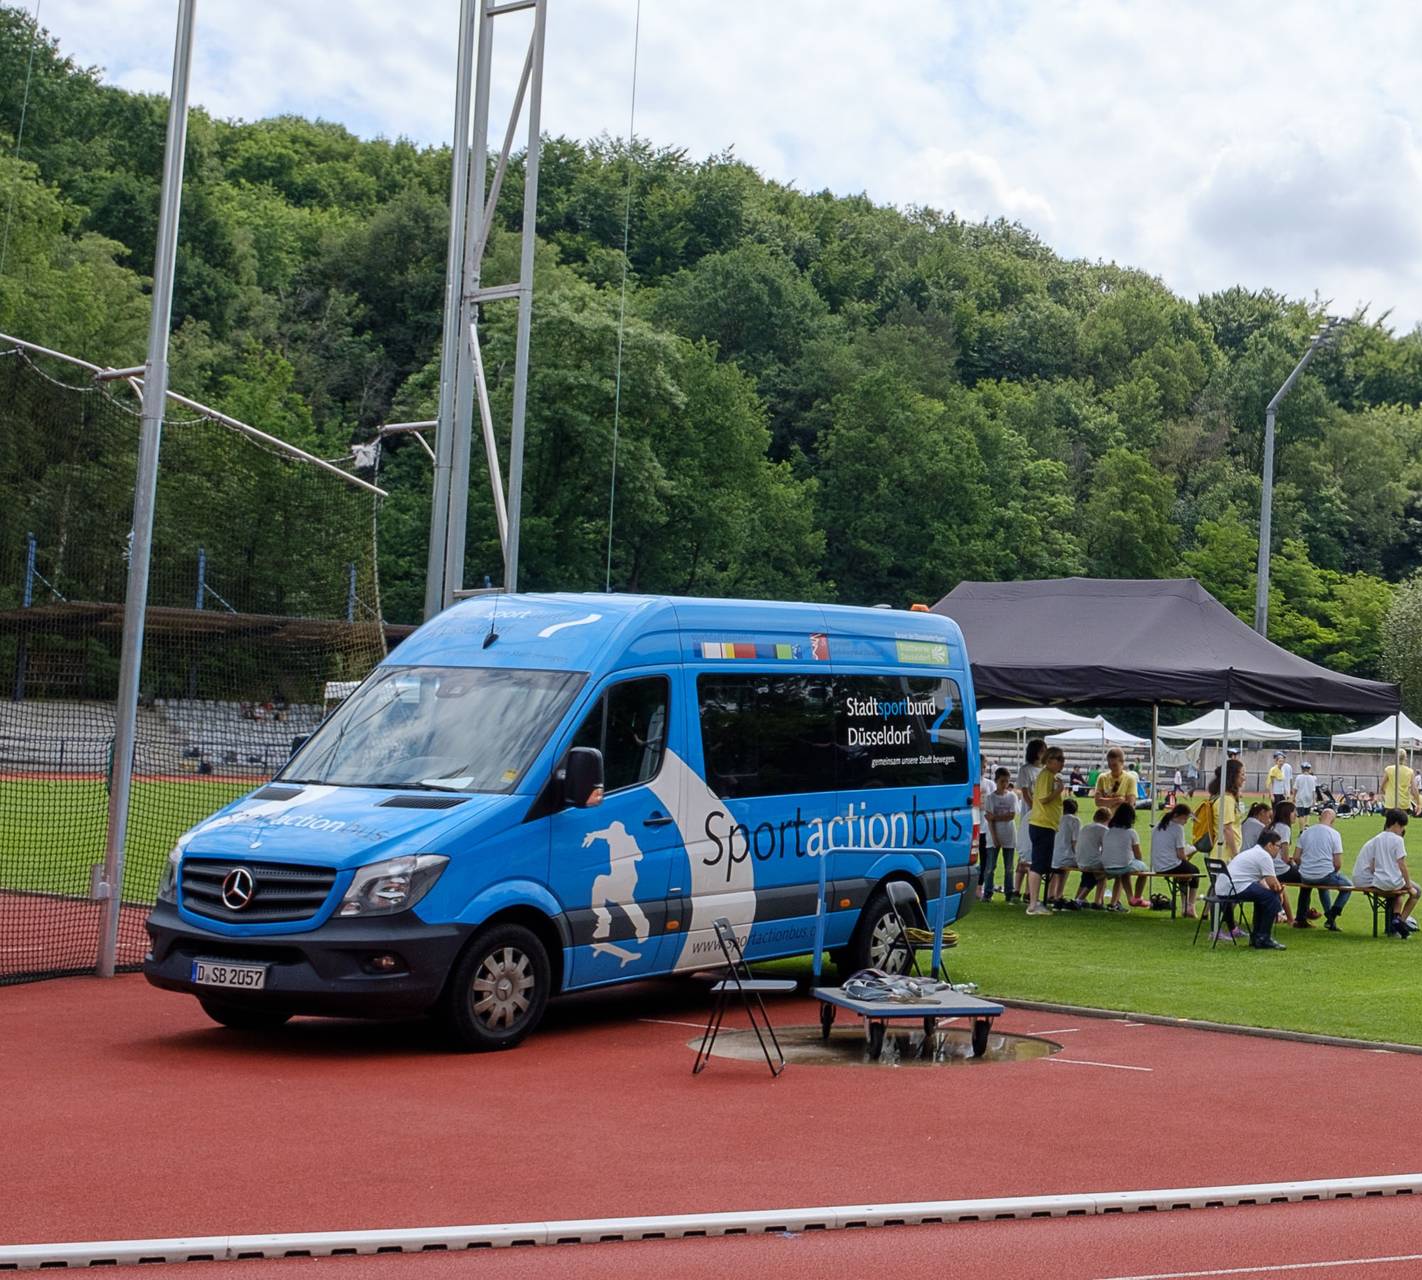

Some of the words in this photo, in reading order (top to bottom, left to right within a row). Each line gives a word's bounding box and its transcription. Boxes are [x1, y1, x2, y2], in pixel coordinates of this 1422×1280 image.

[846, 696, 936, 720] Stadtsportbund
[848, 724, 912, 746] Düsseldorf
[871, 758, 901, 769] gemeinsam
[901, 757, 919, 765] unsere
[919, 755, 932, 765] Stadt
[703, 796, 963, 882] Sportactionbus
[197, 965, 205, 981] D
[211, 967, 227, 984] SB
[229, 969, 263, 986] 2057
